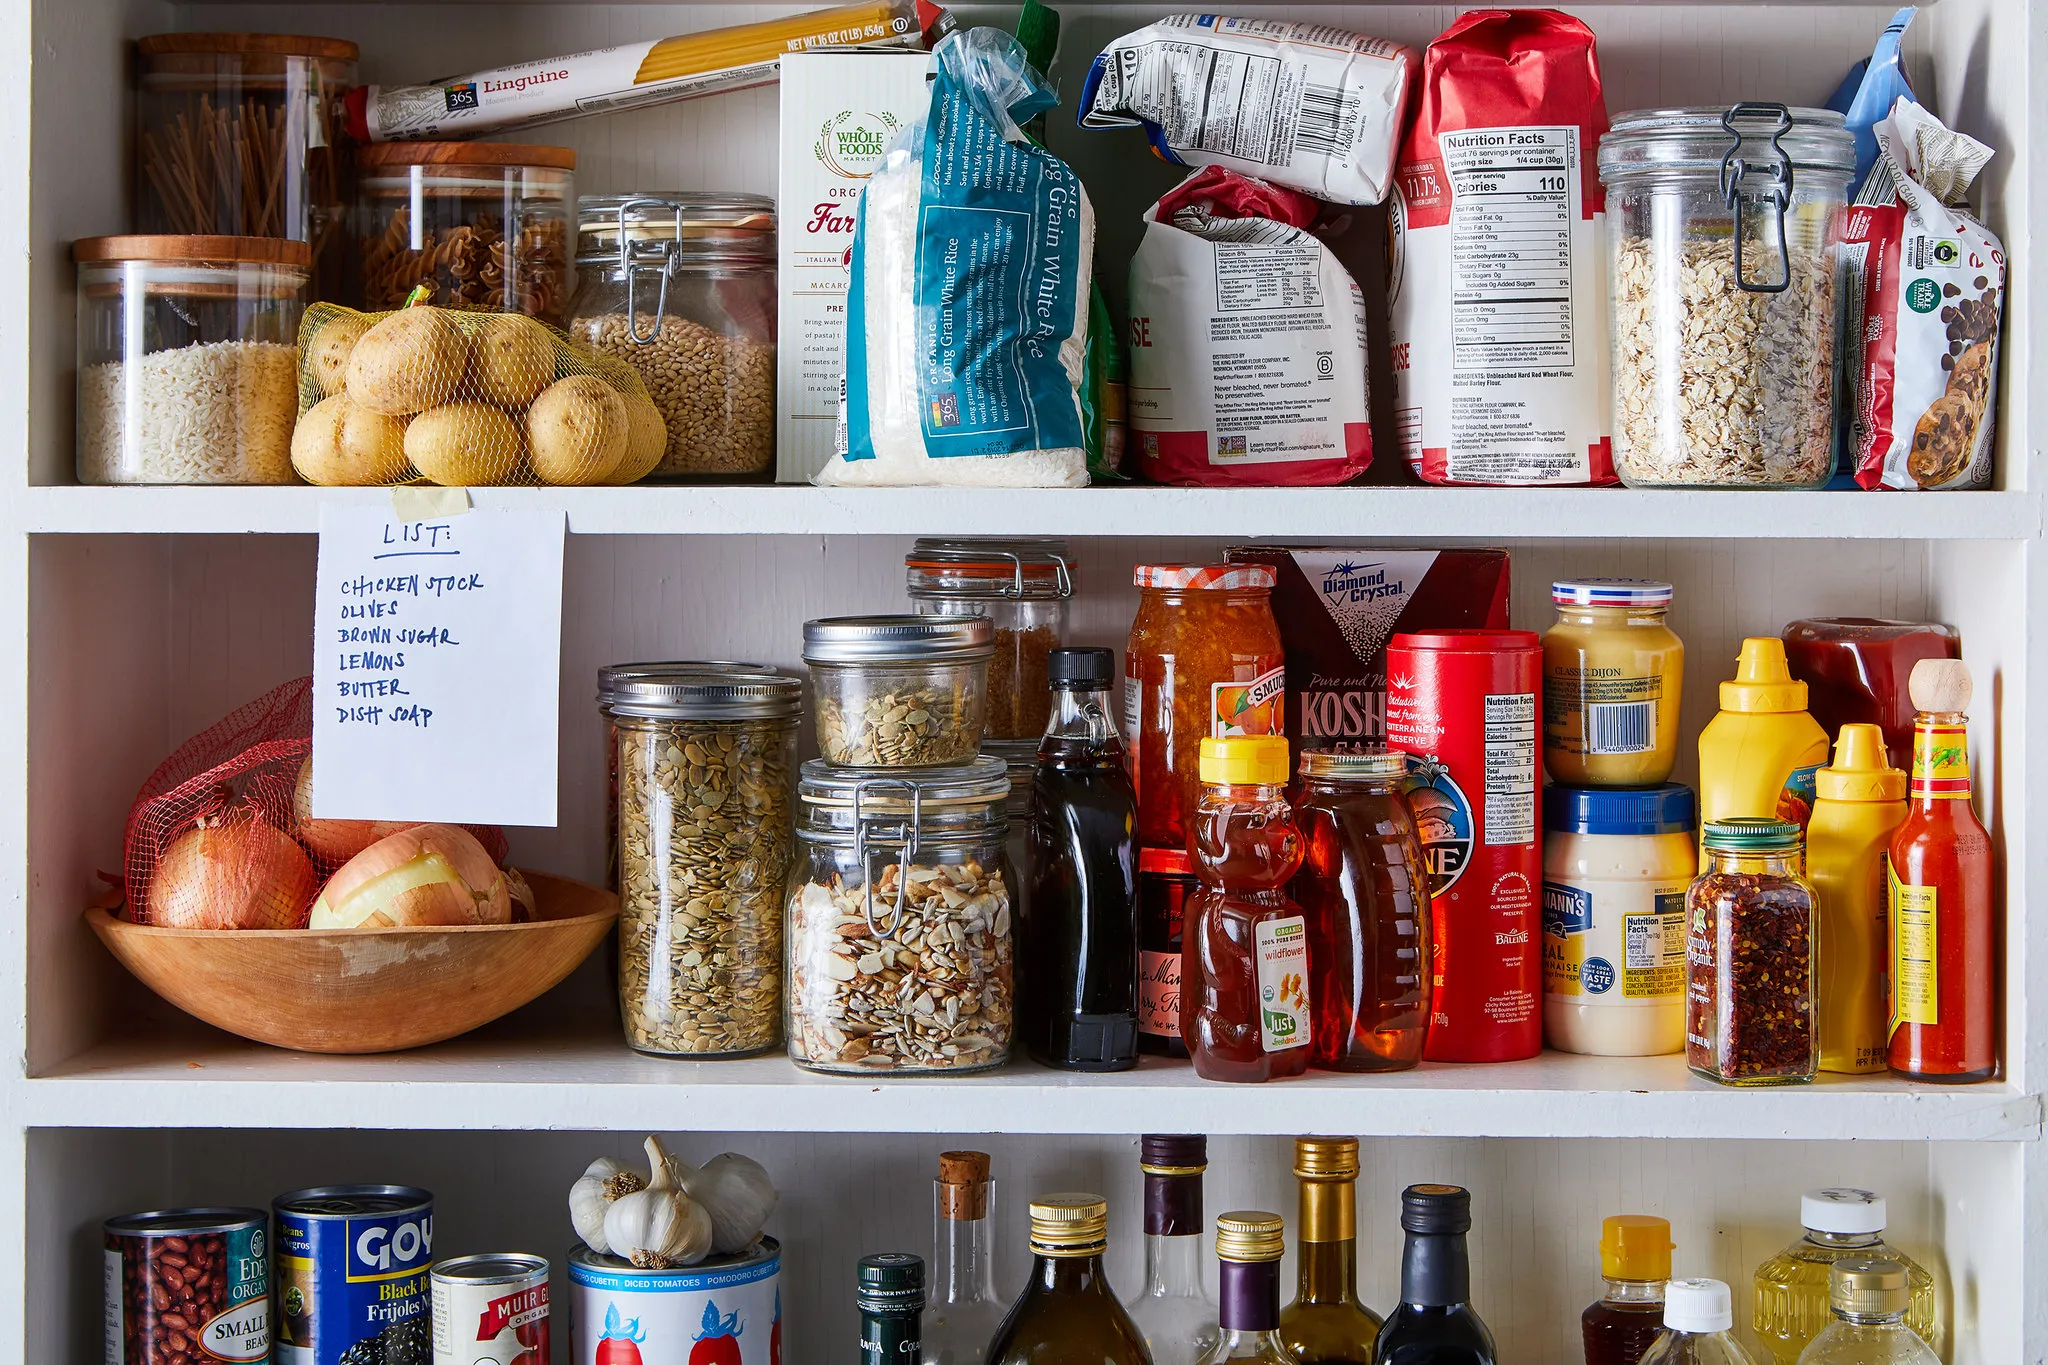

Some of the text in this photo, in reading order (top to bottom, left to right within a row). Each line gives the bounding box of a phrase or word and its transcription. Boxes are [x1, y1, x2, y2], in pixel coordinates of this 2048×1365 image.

[787, 40, 803, 51] NET
[817, 35, 827, 46] 16
[827, 33, 839, 45] OZ
[863, 24, 884, 38] 454g
[1124, 50, 1136, 81] 110
[483, 69, 569, 94] Linguine
[450, 91, 474, 107] 365
[837, 131, 884, 143] WHOLE
[987, 133, 997, 151] Bring
[1448, 133, 1545, 149] Nutrition Facts
[839, 144, 882, 155] FOODS
[946, 142, 955, 162] about
[963, 139, 971, 155] rinse
[1449, 150, 1467, 159] about
[1479, 149, 1509, 157] servings
[997, 146, 1006, 176] simmer
[1450, 159, 1476, 168] Serving
[1529, 157, 1543, 165] cup
[1545, 156, 1563, 165] (30g)
[944, 162, 952, 186] Makes
[960, 171, 968, 187] Sort
[972, 169, 980, 187] with
[1408, 175, 1441, 198] 11.7%
[1457, 177, 1565, 194] Calories 110
[1027, 187, 1068, 359] Grain White Rice
[1923, 281, 1933, 309] WHOLE
[940, 238, 959, 384] Long Grain White Rice
[928, 323, 938, 385] ORGANIC
[1225, 391, 1265, 400] preservatives.
[941, 398, 956, 423] 365
[383, 523, 451, 547] LIST:
[341, 573, 484, 597] CHICKEN STOCK
[1323, 569, 1385, 594] Diamond
[341, 600, 398, 618] OLIVES
[337, 626, 459, 647] BROWN SUGAR
[339, 651, 405, 671] LEMONS
[1310, 672, 1340, 688] Pure
[1343, 673, 1369, 687] and
[1555, 667, 1621, 678] CLASSIC DIJON
[337, 679, 410, 698] BUTTER
[1486, 696, 1534, 706] Nutrition Facts
[336, 704, 433, 727] DISH SOAP
[1389, 734, 1427, 745] PRESERVE
[1276, 925, 1302, 936] ORGANIC
[1627, 917, 1659, 926] Nutrition
[1627, 925, 1648, 933] Facts
[1495, 932, 1529, 945] BALEINE
[1265, 945, 1305, 960] wildflower
[1583, 973, 1611, 985] TASTE
[1269, 1014, 1293, 1033] Just
[1434, 1012, 1449, 1027] 750g
[590, 1275, 619, 1287] CUBETTI
[624, 1279, 650, 1288] DICED
[652, 1278, 700, 1288] TOMATOES
[707, 1271, 752, 1285] POMODORO
[379, 1281, 418, 1301] Black
[367, 1300, 420, 1323] Frijoles
[497, 1291, 537, 1320] MUIR
[215, 1315, 265, 1340] SMALL
